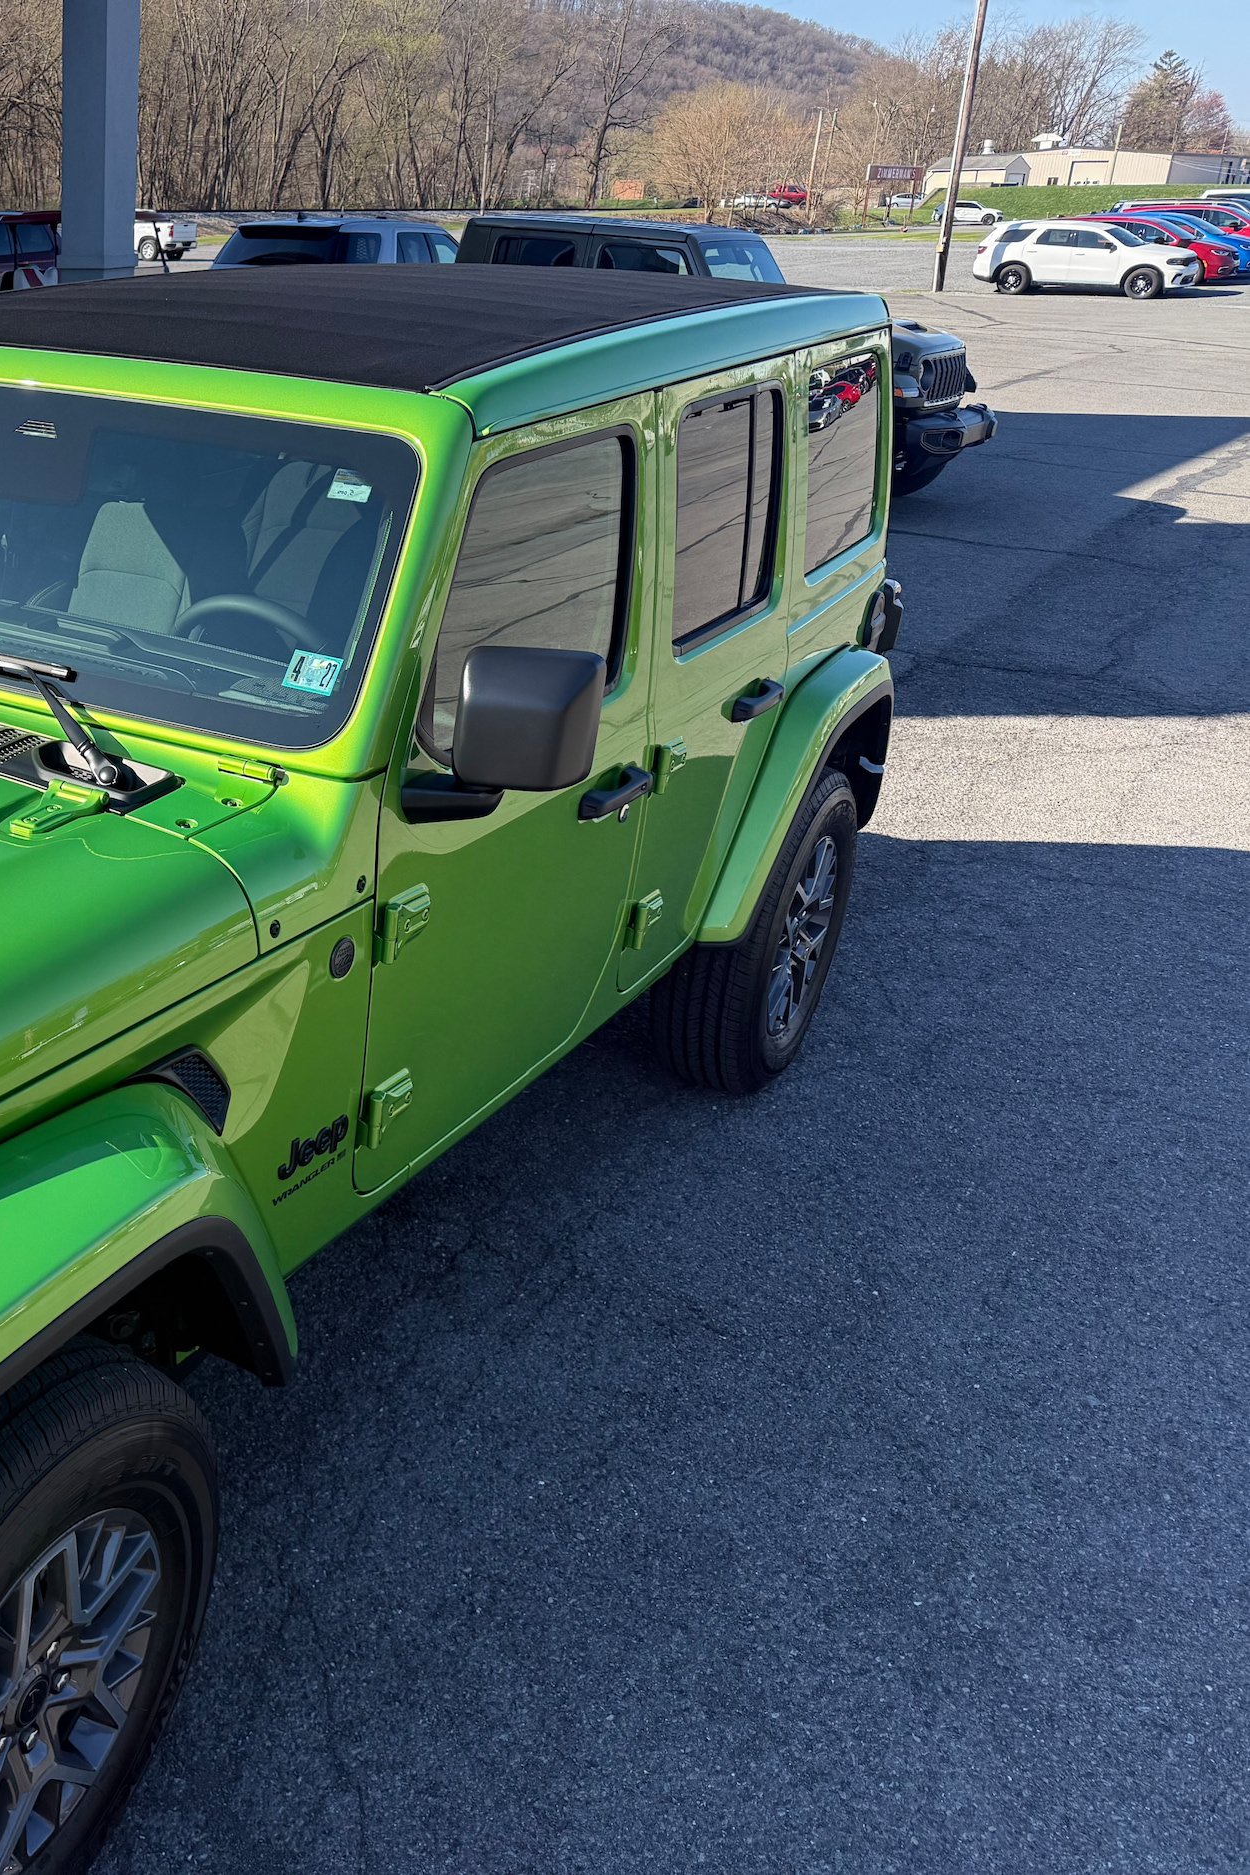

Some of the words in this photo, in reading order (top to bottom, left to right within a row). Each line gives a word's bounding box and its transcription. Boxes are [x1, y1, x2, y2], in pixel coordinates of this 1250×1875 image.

[292, 656, 306, 682] 4
[319, 662, 338, 688] 27
[277, 1113, 349, 1181] Jeep
[271, 1157, 336, 1206] WRANGLER
